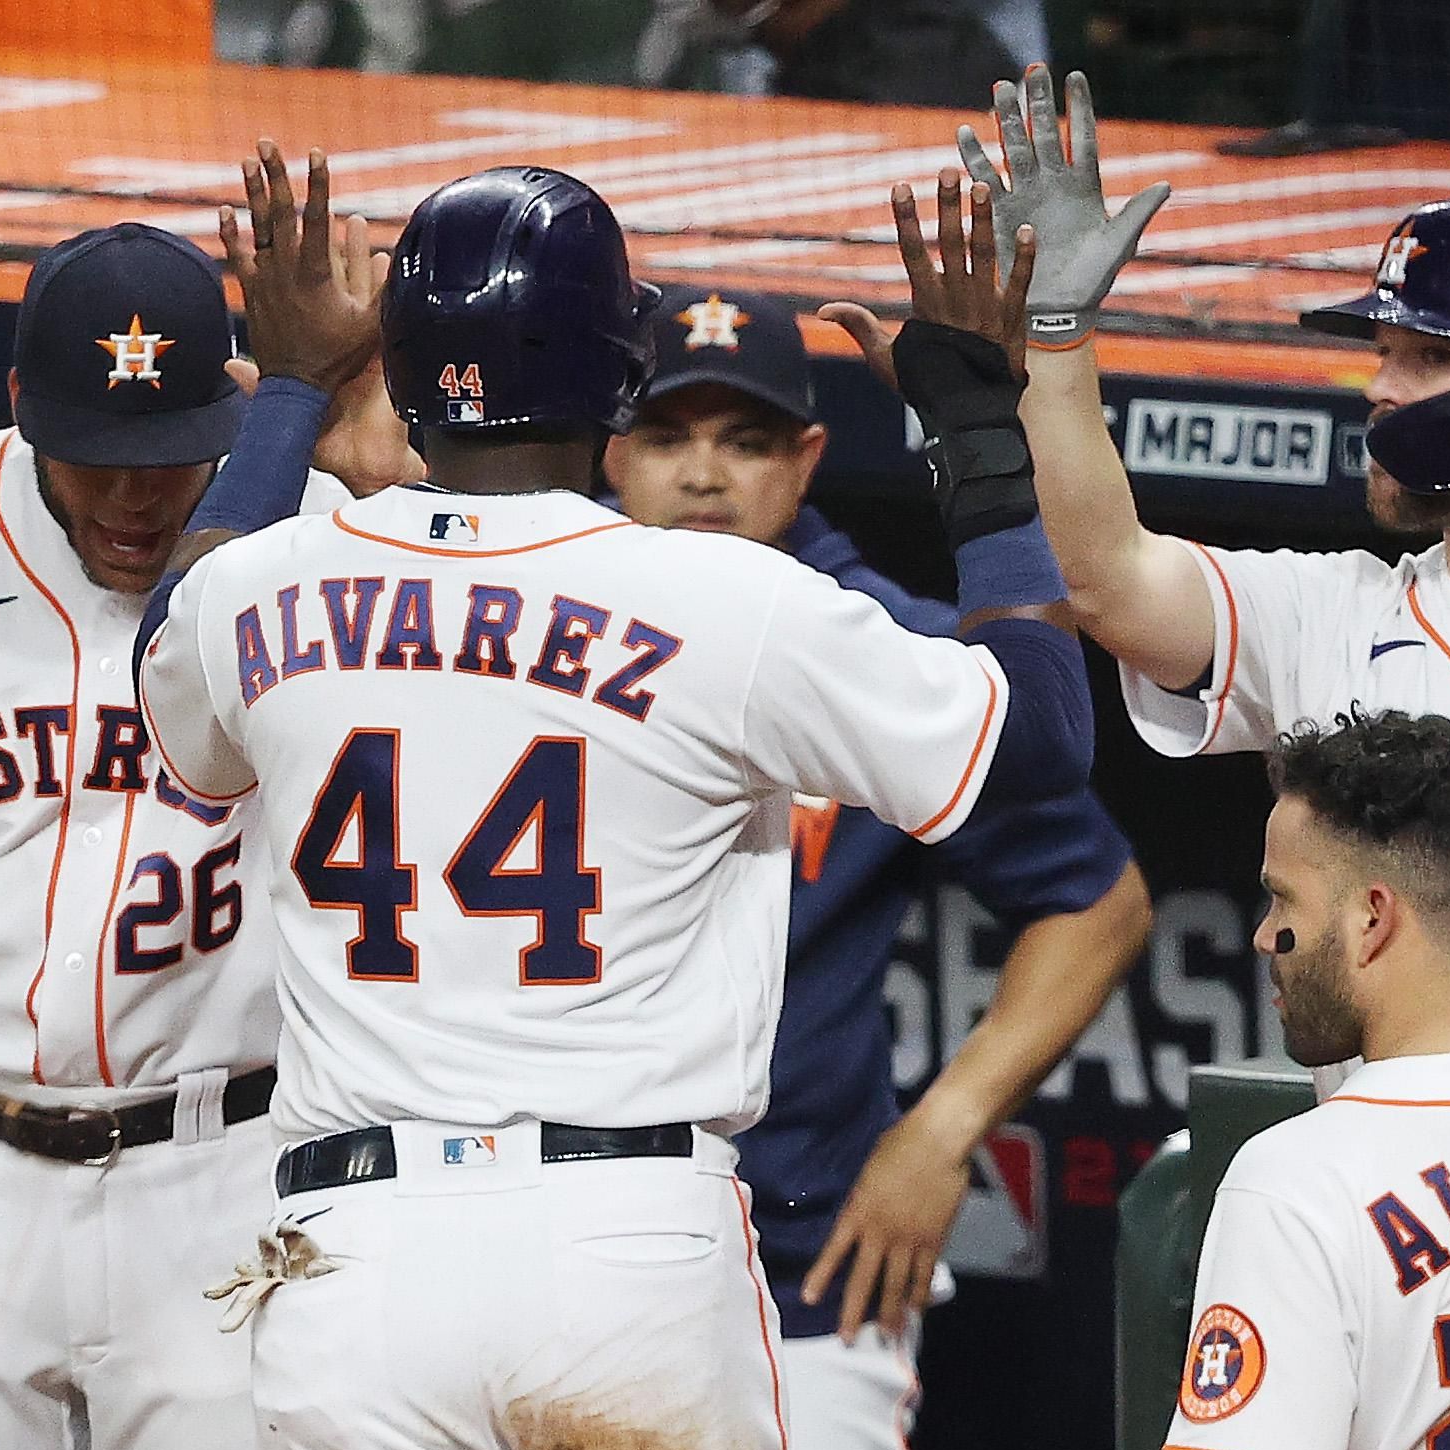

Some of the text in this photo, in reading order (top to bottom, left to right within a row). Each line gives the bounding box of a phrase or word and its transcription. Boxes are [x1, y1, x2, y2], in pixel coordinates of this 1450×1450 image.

[438, 363, 484, 397] 44
[1141, 411, 1314, 470] MAJOR
[235, 576, 683, 722] ALVAREZ
[114, 828, 243, 976] 26
[291, 727, 603, 986] 44
